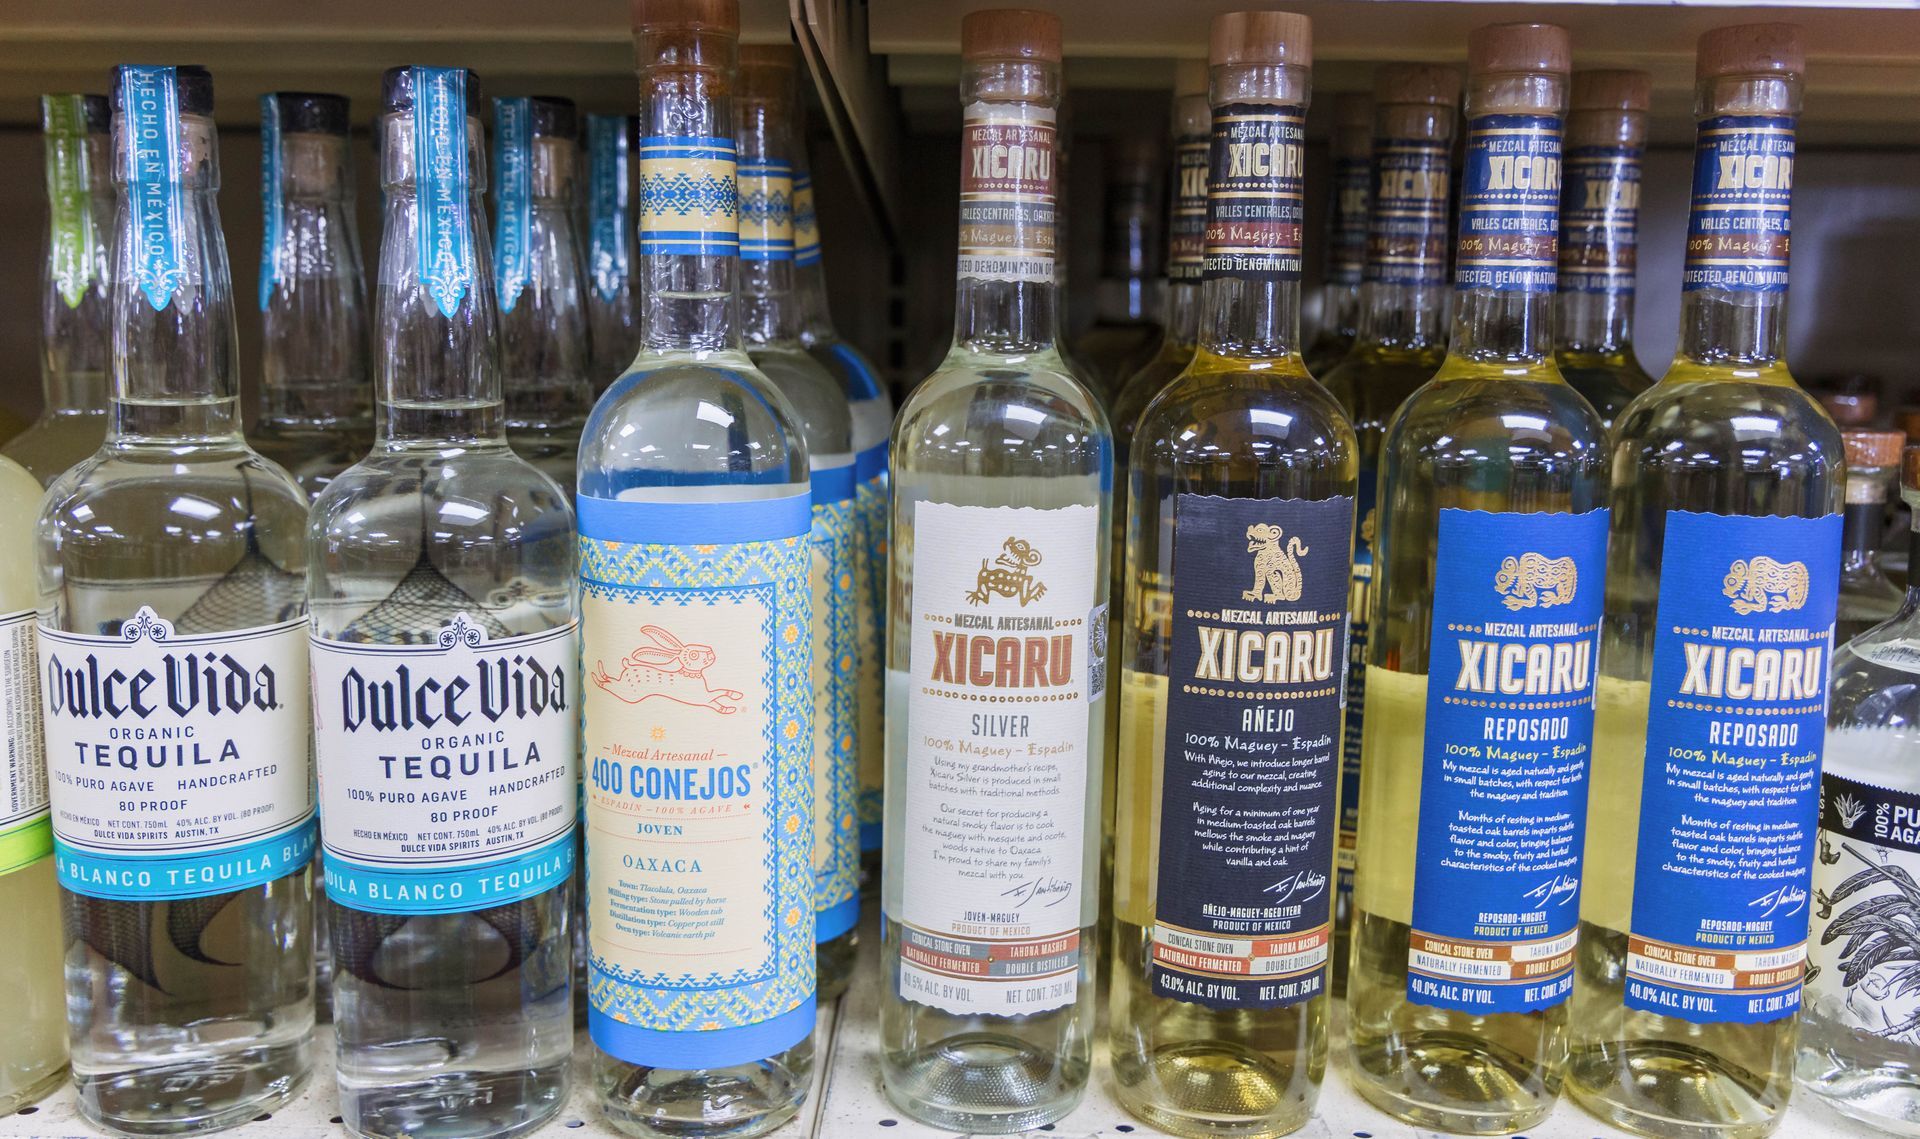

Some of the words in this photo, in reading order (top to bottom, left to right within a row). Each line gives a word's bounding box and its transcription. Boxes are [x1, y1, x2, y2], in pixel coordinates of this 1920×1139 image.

[139, 72, 157, 140] HECHO
[1231, 126, 1266, 139] MEZCAL
[1489, 141, 1525, 152] MEZCAL
[1720, 140, 1758, 152] MEZCAL
[143, 150, 160, 174] EN
[972, 145, 1050, 180] XICARU
[1228, 144, 1303, 177] XICARU
[1216, 205, 1242, 218] VALLES
[975, 260, 1043, 274] DENOMINATION
[1236, 258, 1298, 272] DENOMINATION
[955, 614, 994, 630] MEZCAL
[997, 617, 1055, 630] ARTESANAL
[1222, 609, 1263, 624] MEZCAL
[1265, 611, 1318, 625] ARTESANAL
[1485, 622, 1526, 637] MEZCAL
[1529, 623, 1578, 638] ARTESANAL
[1712, 626, 1754, 641] MEZCAL
[1758, 628, 1809, 643] ARTESANAL
[931, 630, 1073, 688] XICARU
[1195, 626, 1334, 684] XICARU
[1455, 640, 1590, 695] XICARU
[1679, 643, 1822, 701] XICARU
[49, 652, 157, 719] Dulce
[341, 663, 471, 733] Dulce
[972, 714, 1029, 737] SILVER
[1242, 705, 1294, 732] AÑEJO
[110, 726, 194, 740] ORGANIC
[1484, 716, 1568, 741] REPOSADO
[1709, 721, 1798, 746] REPOSADO
[422, 730, 504, 750] ORGANIC
[924, 736, 954, 751] 100%
[959, 740, 1011, 759] Maguey
[1185, 733, 1219, 748] 100%
[1225, 736, 1278, 754] Maguey
[1292, 735, 1331, 751] Espadín
[75, 739, 240, 771] TEQUILA
[379, 742, 540, 780] TEQUILA
[612, 744, 648, 759] Mezcal
[651, 749, 714, 761] Artesanal
[1184, 750, 1205, 763] With
[1250, 759, 1290, 767] introduce
[1445, 743, 1480, 758] 100%
[1486, 746, 1538, 763] Maguey
[1669, 746, 1706, 762] 100%
[1711, 751, 1766, 769] Maguey
[76, 776, 104, 790] PURO
[110, 781, 154, 792] AGAVE
[178, 765, 278, 790] HANDCRAFTED
[347, 788, 374, 801] 100%
[379, 792, 415, 803] PURO
[422, 790, 467, 803] AGAVE
[489, 765, 565, 796] HANDCRAFTED
[592, 757, 622, 794] 400
[630, 765, 751, 800] CONEJOS
[991, 776, 1031, 787] produced
[1229, 771, 1238, 779] to
[960, 785, 977, 796] with
[980, 785, 1025, 796] traditional
[1191, 779, 1235, 792] additional
[1238, 781, 1281, 795] complexity
[1283, 784, 1297, 792] and
[119, 801, 135, 810] 80
[141, 800, 188, 810] PROOF
[431, 812, 447, 822] 80
[453, 806, 498, 821] PROOF
[940, 803, 955, 814] Our
[957, 808, 984, 817] secret
[986, 808, 999, 817] for
[1001, 809, 1042, 820] producing
[108, 820, 120, 828] NET
[194, 817, 210, 825] ALC.
[212, 815, 221, 823] BY
[224, 812, 238, 821] VOL.
[418, 832, 431, 841] NET
[433, 832, 454, 841] CONT.
[488, 824, 501, 834] 40%
[503, 821, 517, 832] ALC.
[519, 818, 526, 828] BY
[637, 823, 683, 835] JOVEN
[962, 821, 987, 832] smoky
[990, 822, 1014, 830] flavor
[1874, 803, 1890, 838] 100%
[94, 830, 115, 838] DULCE
[401, 843, 425, 853] DULCE
[428, 842, 446, 852] VIDA
[449, 840, 479, 851] SPIRITS
[516, 831, 524, 839] TX
[70, 864, 150, 887] BLANCO
[167, 854, 272, 886] TEQUILA
[623, 855, 702, 873] OAXACA
[369, 882, 463, 901] BLANCO
[478, 856, 561, 894] TEQUILA
[608, 887, 630, 900] Milling
[668, 896, 693, 906] pulled
[609, 910, 646, 924] Distillation
[668, 920, 694, 928] Copper
[964, 911, 1020, 922] JOVEN-MAGUEY
[1213, 919, 1250, 931] PRODUCT
[1252, 922, 1262, 931] OF
[1264, 921, 1290, 930] MEXICO
[616, 923, 629, 932] Oven
[952, 923, 986, 934] PRODUCT
[990, 926, 1000, 935] OF
[1002, 926, 1031, 936] MEXICO
[1474, 926, 1509, 936] PRODUCT
[1513, 928, 1522, 936] OF
[1168, 934, 1193, 948] CONICAL
[1194, 940, 1214, 952] STONE
[1217, 943, 1233, 954] OVEN
[1696, 932, 1734, 944] PRODUCT
[1737, 935, 1747, 944] OF
[1159, 947, 1196, 966] NATURALLY
[1199, 957, 1242, 972] FERMENTED
[1454, 944, 1474, 958] STONE
[1644, 945, 1672, 960] CONICAL
[1674, 951, 1696, 964] STONE
[1417, 955, 1456, 972] NATURALLY
[1459, 961, 1501, 976] FERMENTED
[1636, 959, 1677, 978] NATURALLY
[1680, 969, 1724, 985] FERMENTED
[942, 985, 953, 999] BY
[1186, 980, 1204, 996] ALC.
[1207, 984, 1219, 998] BY
[1221, 986, 1239, 1000] VOL.
[1440, 985, 1459, 1001] ALC.
[1462, 989, 1474, 1003] BY
[1476, 989, 1495, 1004] VOL.
[1659, 991, 1679, 1008] ALC.
[1682, 995, 1696, 1010] BY
[1698, 997, 1717, 1013] VOL.
